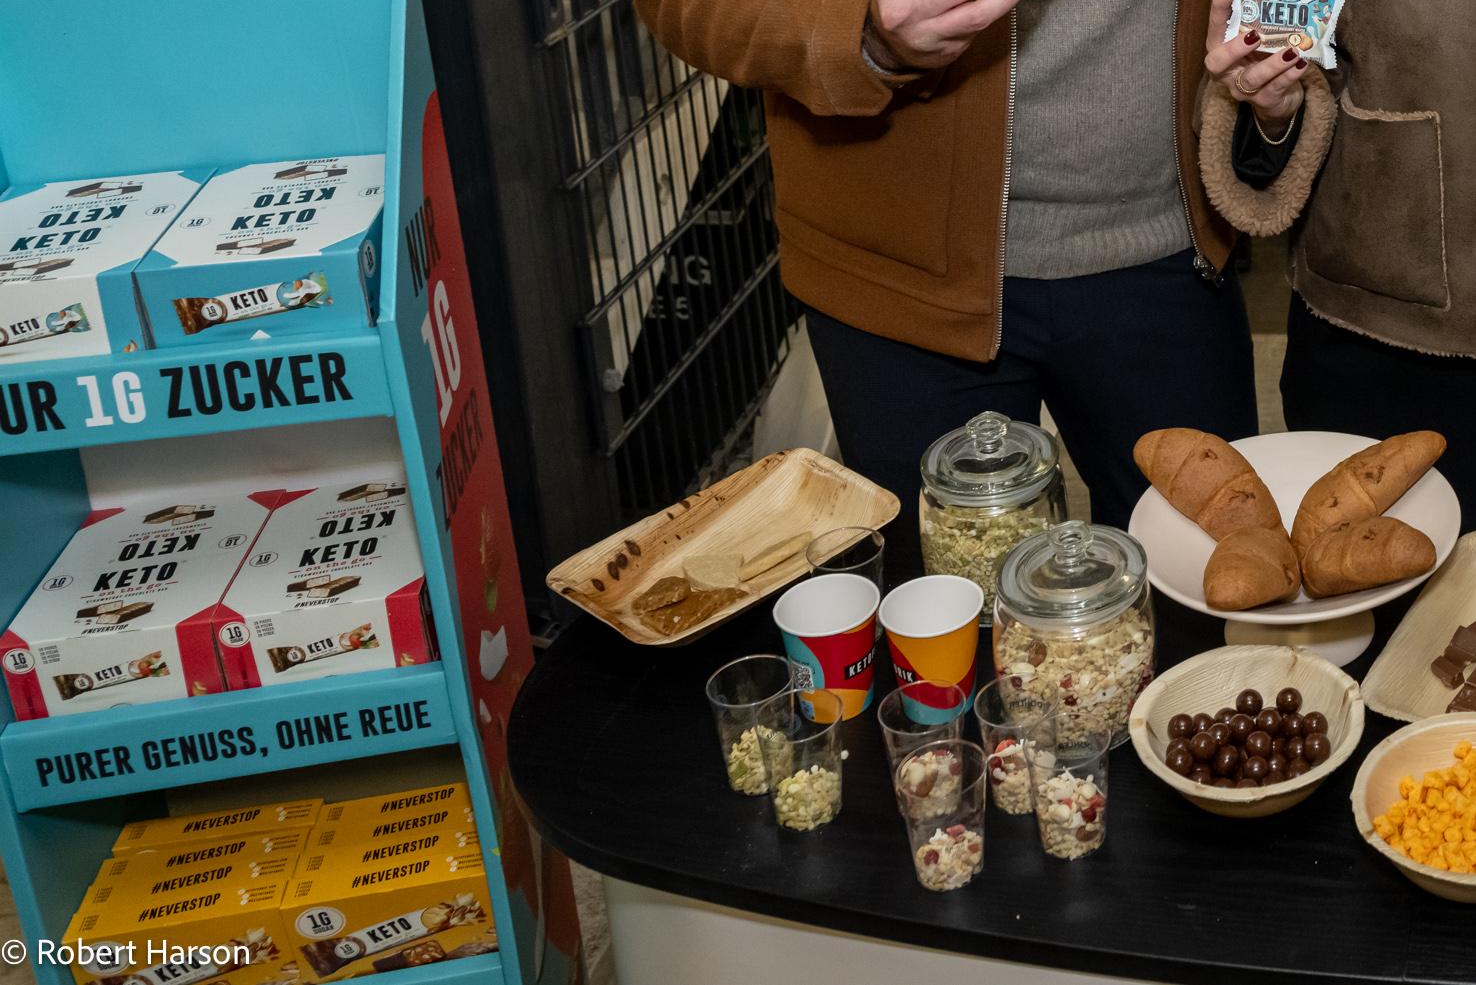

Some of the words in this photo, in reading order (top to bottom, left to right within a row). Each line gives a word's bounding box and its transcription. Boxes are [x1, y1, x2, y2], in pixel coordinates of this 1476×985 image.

[1261, 1, 1309, 26] KETO
[230, 208, 316, 231] KETO
[9, 227, 102, 252] KETO
[405, 196, 441, 298] NUR
[230, 288, 269, 311] KETO
[10, 318, 40, 335] KETO
[421, 280, 461, 429] 1G
[76, 371, 147, 428] 1G
[160, 351, 354, 419] ZUCKER
[319, 509, 397, 537] KETO
[118, 533, 201, 561] KETO
[298, 537, 379, 567] KETO
[93, 561, 178, 592] KETO
[307, 638, 334, 654] KETO
[94, 666, 122, 682] KETO
[36, 745, 135, 787] PURER
[141, 726, 269, 772] GENUSS,
[276, 712, 352, 750] OHNE
[360, 700, 432, 738] REUE
[380, 787, 455, 813] #NEVERSTOP
[182, 809, 261, 834] #NEVERSTOP
[372, 811, 448, 837] #NEVERSTOP
[166, 841, 246, 868] #NEVERSTOP
[362, 835, 439, 863] #NEVERSTOP
[151, 866, 232, 894] #NEVERSTOP
[352, 860, 430, 888] #NEVERSTOP
[137, 893, 221, 923] #NEVERSTOP
[366, 917, 413, 944] KETO
